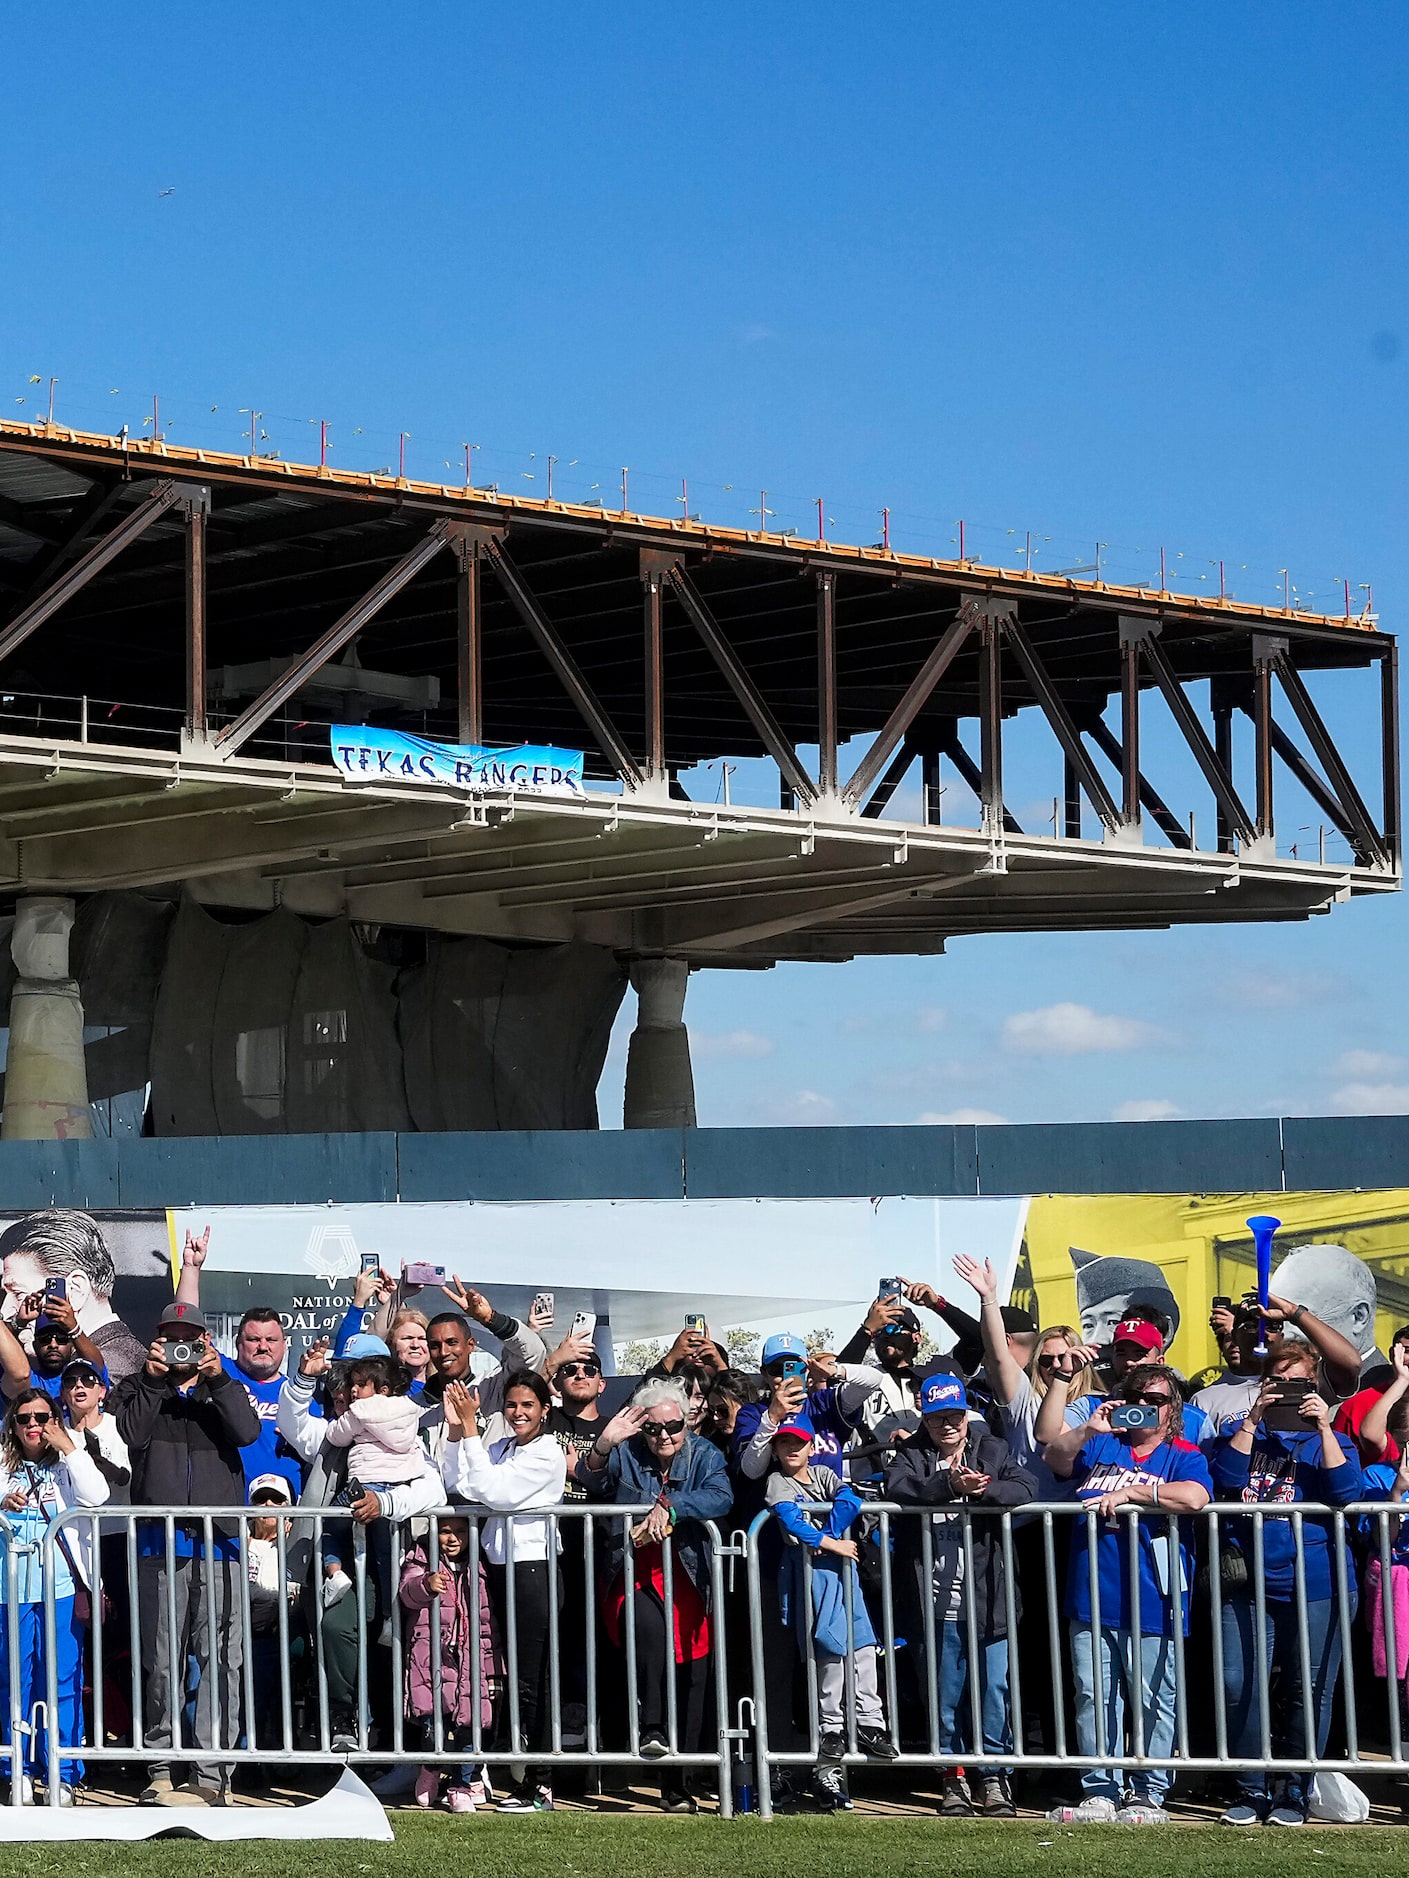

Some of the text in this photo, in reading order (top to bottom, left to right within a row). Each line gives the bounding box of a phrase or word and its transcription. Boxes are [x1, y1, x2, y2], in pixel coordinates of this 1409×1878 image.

[337, 746, 437, 778] TEXAS
[454, 760, 579, 791] RANGERS
[173, 1305, 189, 1318] T
[323, 1312, 338, 1331] of
[1123, 1319, 1141, 1334] T
[344, 1337, 357, 1352] T
[778, 1336, 793, 1349] T
